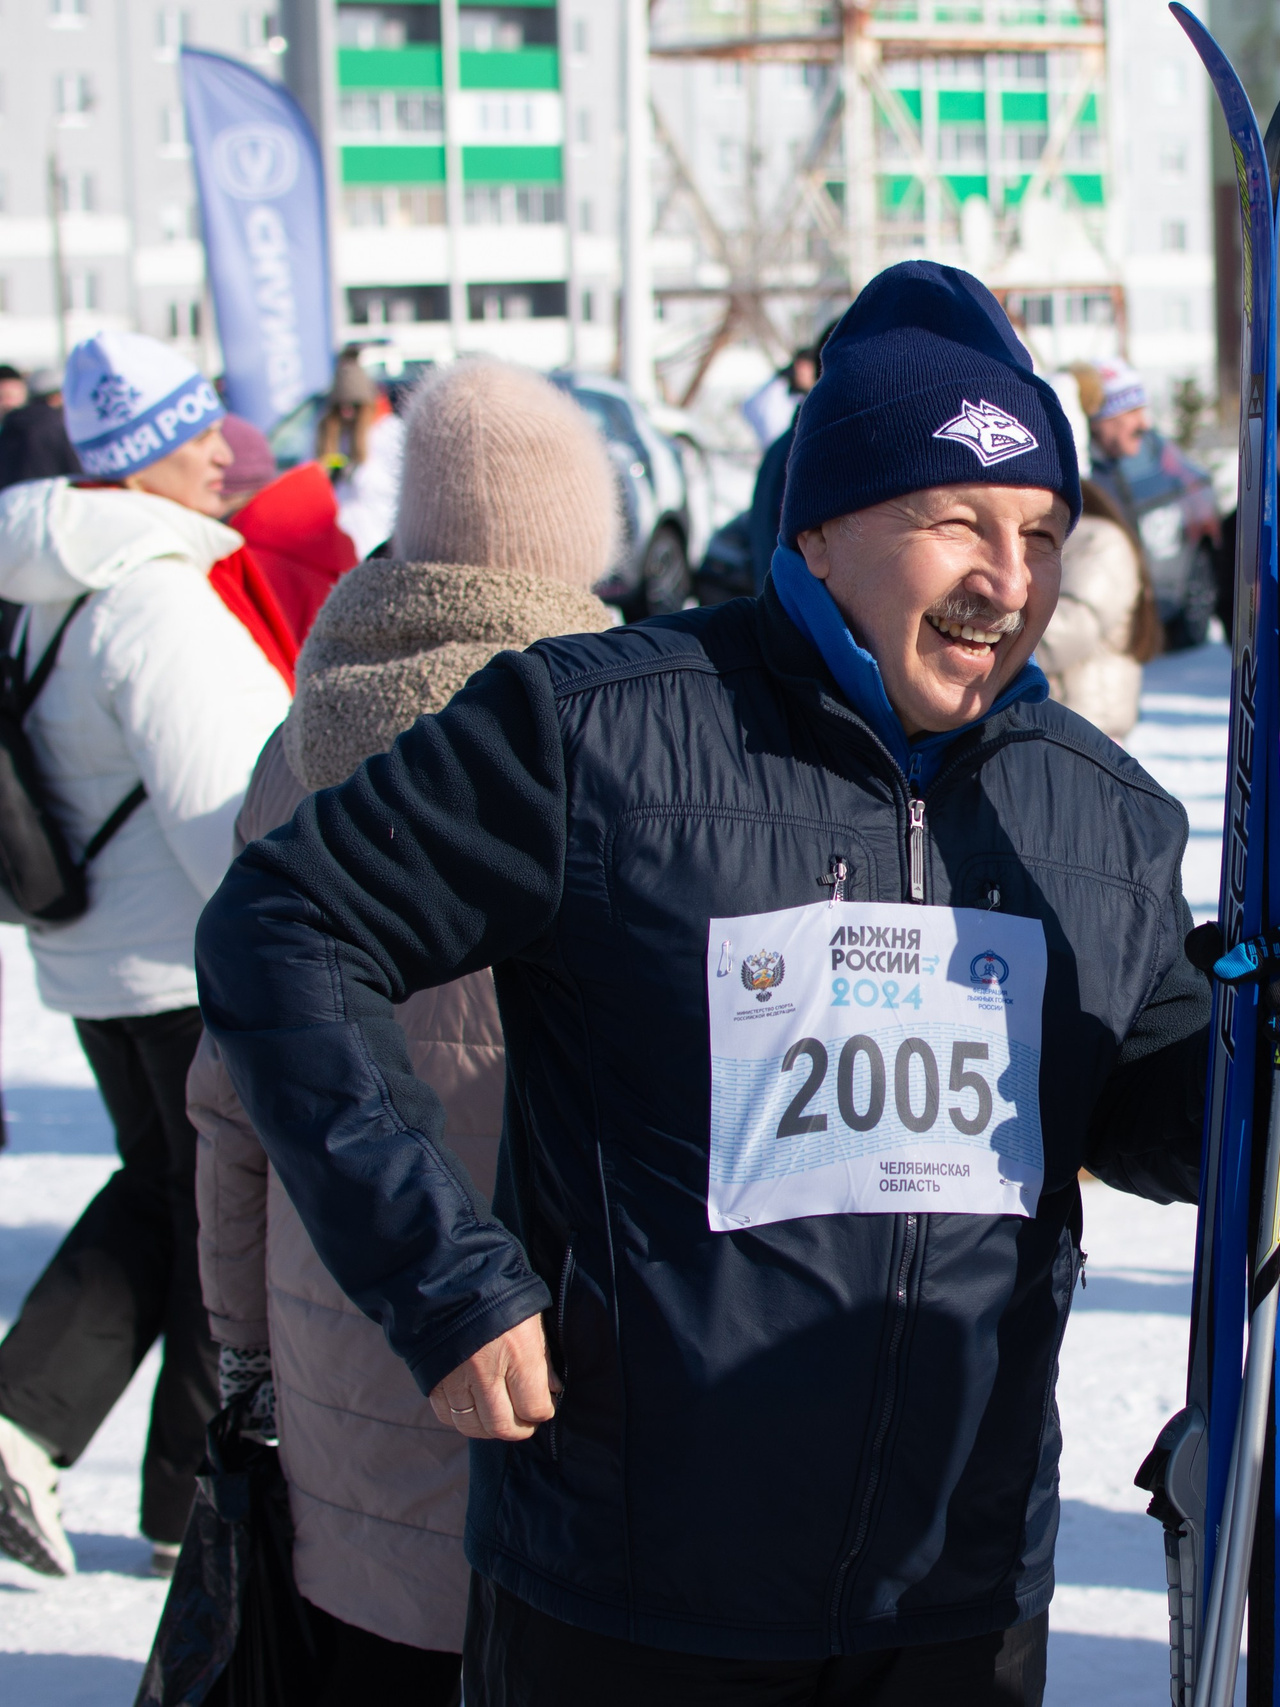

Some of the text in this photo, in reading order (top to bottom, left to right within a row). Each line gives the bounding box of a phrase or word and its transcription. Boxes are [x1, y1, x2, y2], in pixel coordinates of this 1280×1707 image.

[1220, 644, 1258, 1065] FSCHER
[828, 925, 921, 950] ЛЫЖНЯ
[831, 949, 920, 975] РОССИИ
[830, 977, 923, 1010] 2024
[973, 987, 1008, 996] ФЕДЕРАЦИЯ
[733, 1007, 796, 1022] РОССИЙСКОЙ ФЕДЕРАЦИИ
[736, 1002, 794, 1016] МИНИСТЕРСТВО СПОРТА
[978, 1003, 1003, 1011] РОССИИ
[776, 1034, 993, 1140] 2005
[879, 1161, 970, 1178] ЧЕЛЯБИНСКАЯ
[879, 1178, 941, 1193] ОБЛАСТЬ
